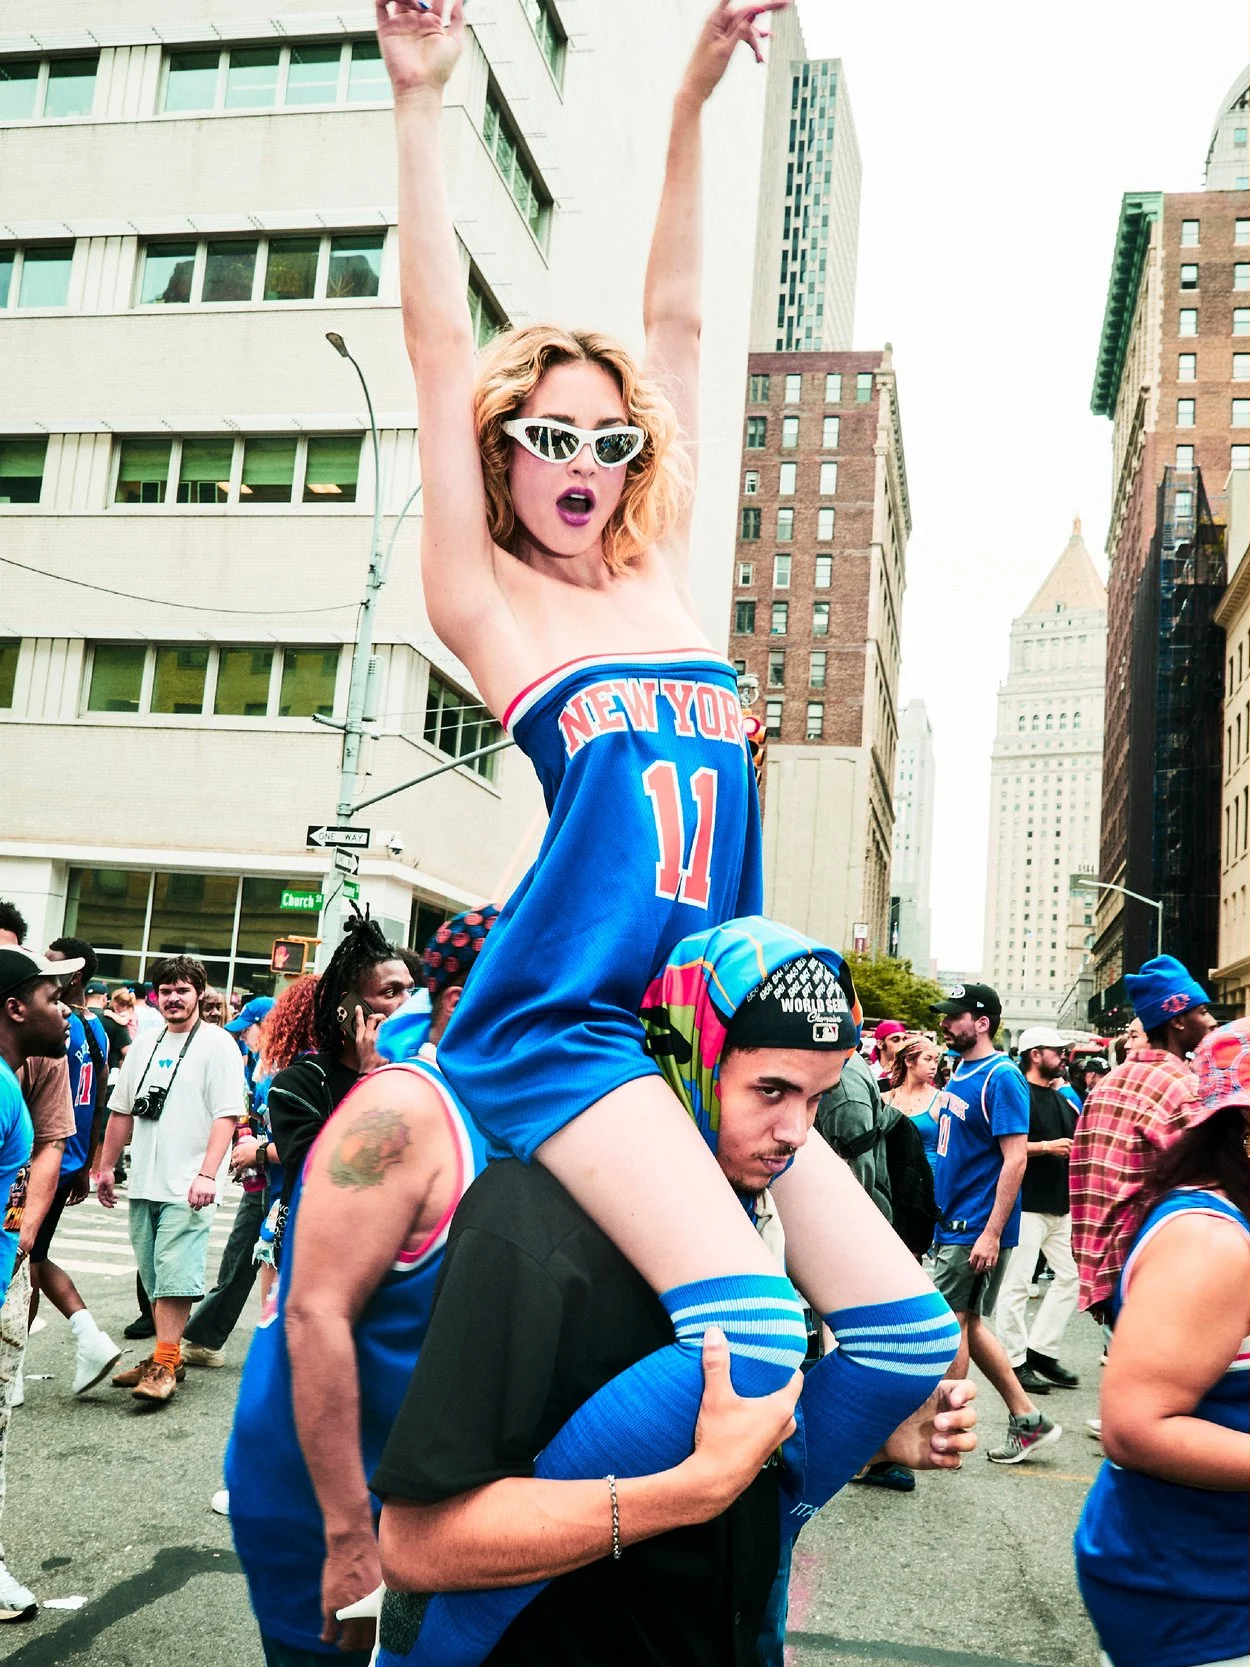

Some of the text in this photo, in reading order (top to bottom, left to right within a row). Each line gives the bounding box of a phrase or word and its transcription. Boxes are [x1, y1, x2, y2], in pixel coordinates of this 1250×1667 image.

[557, 677, 659, 761] NEW
[318, 832, 363, 841] ONE WAY
[642, 759, 718, 910] 11
[282, 893, 322, 908] Church St
[780, 997, 825, 1013] WORLD
